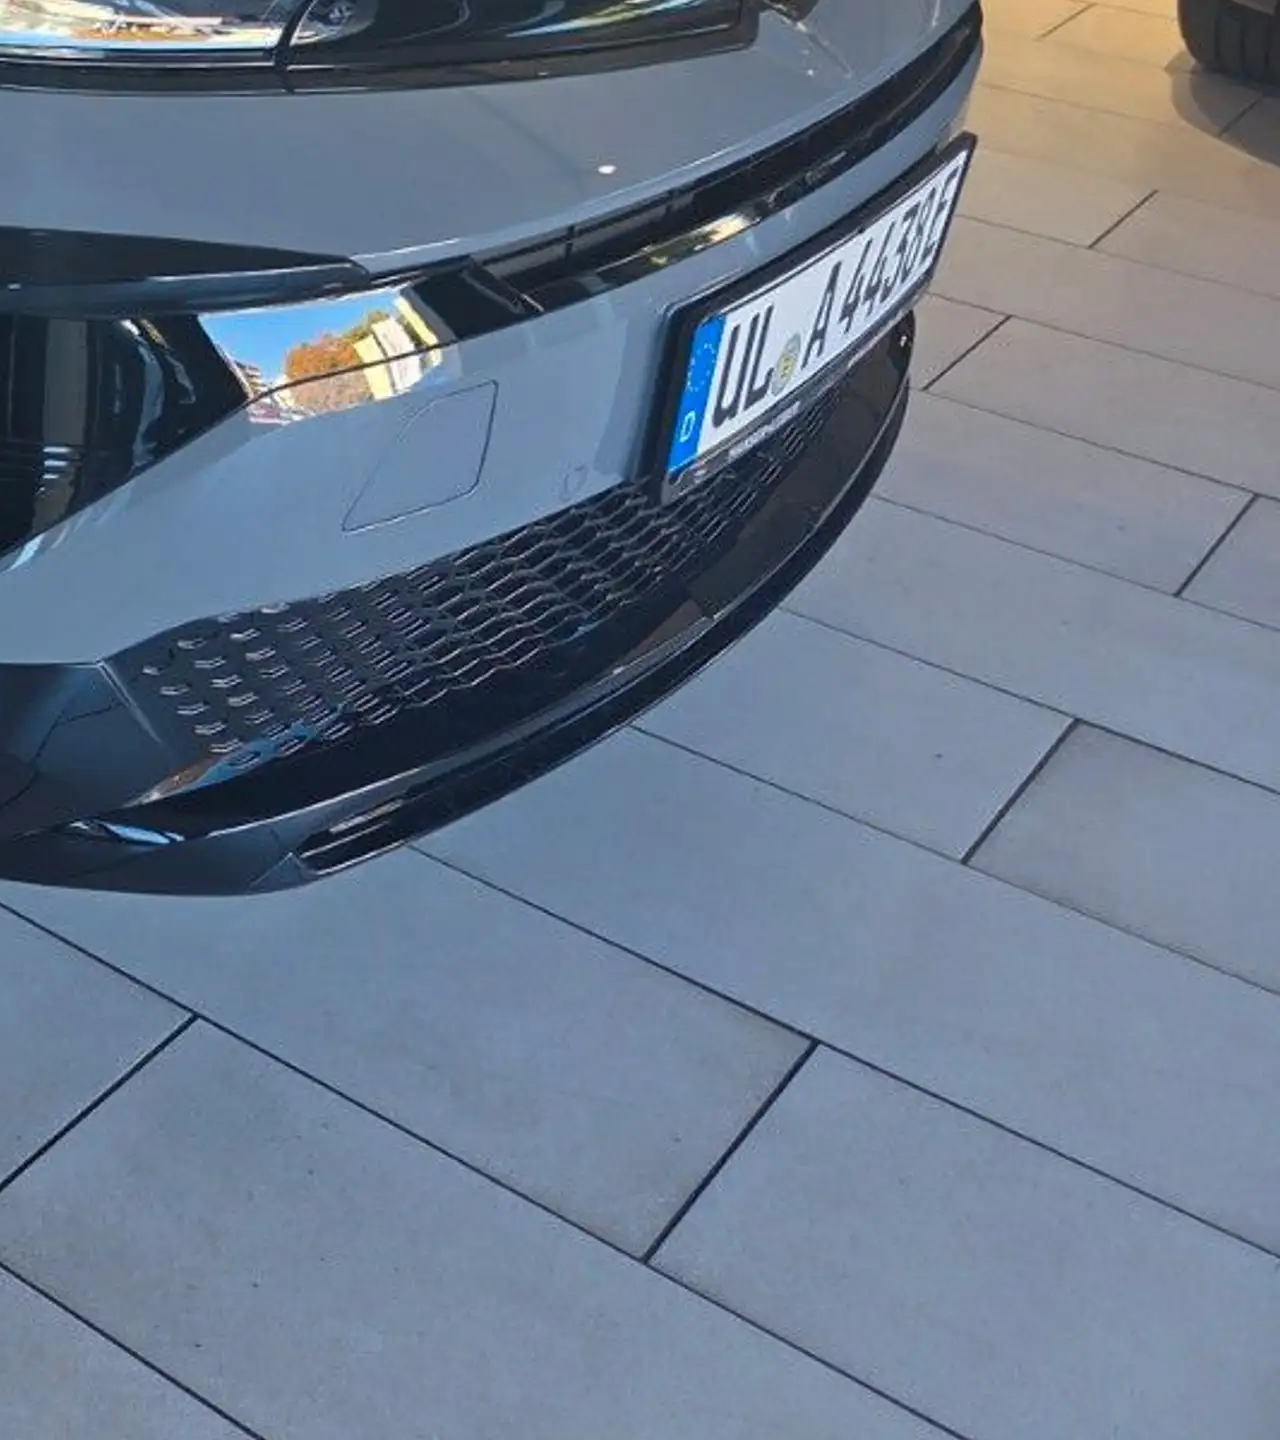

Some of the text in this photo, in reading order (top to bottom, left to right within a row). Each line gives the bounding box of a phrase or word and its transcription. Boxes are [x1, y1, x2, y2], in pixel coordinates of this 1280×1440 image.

[712, 166, 960, 428] UL A 4438E
[679, 410, 697, 443] D
